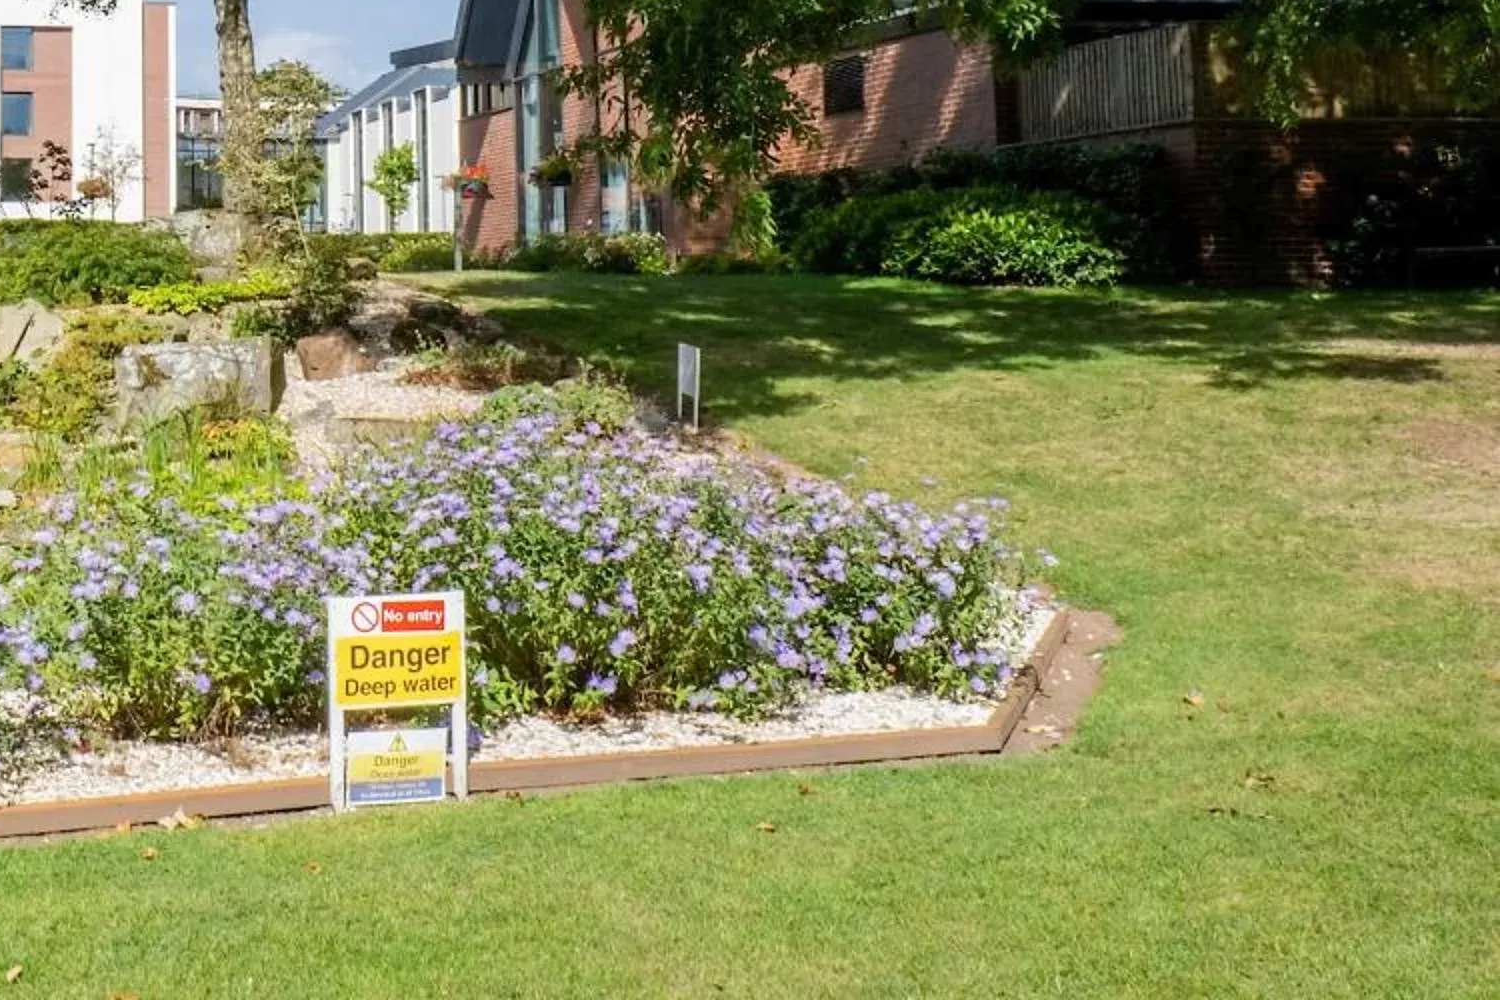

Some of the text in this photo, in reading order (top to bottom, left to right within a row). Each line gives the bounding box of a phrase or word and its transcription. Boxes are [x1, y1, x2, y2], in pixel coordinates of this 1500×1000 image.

[384, 609, 443, 625] No entry
[351, 645, 451, 673] Danger
[345, 675, 456, 698] Deep water
